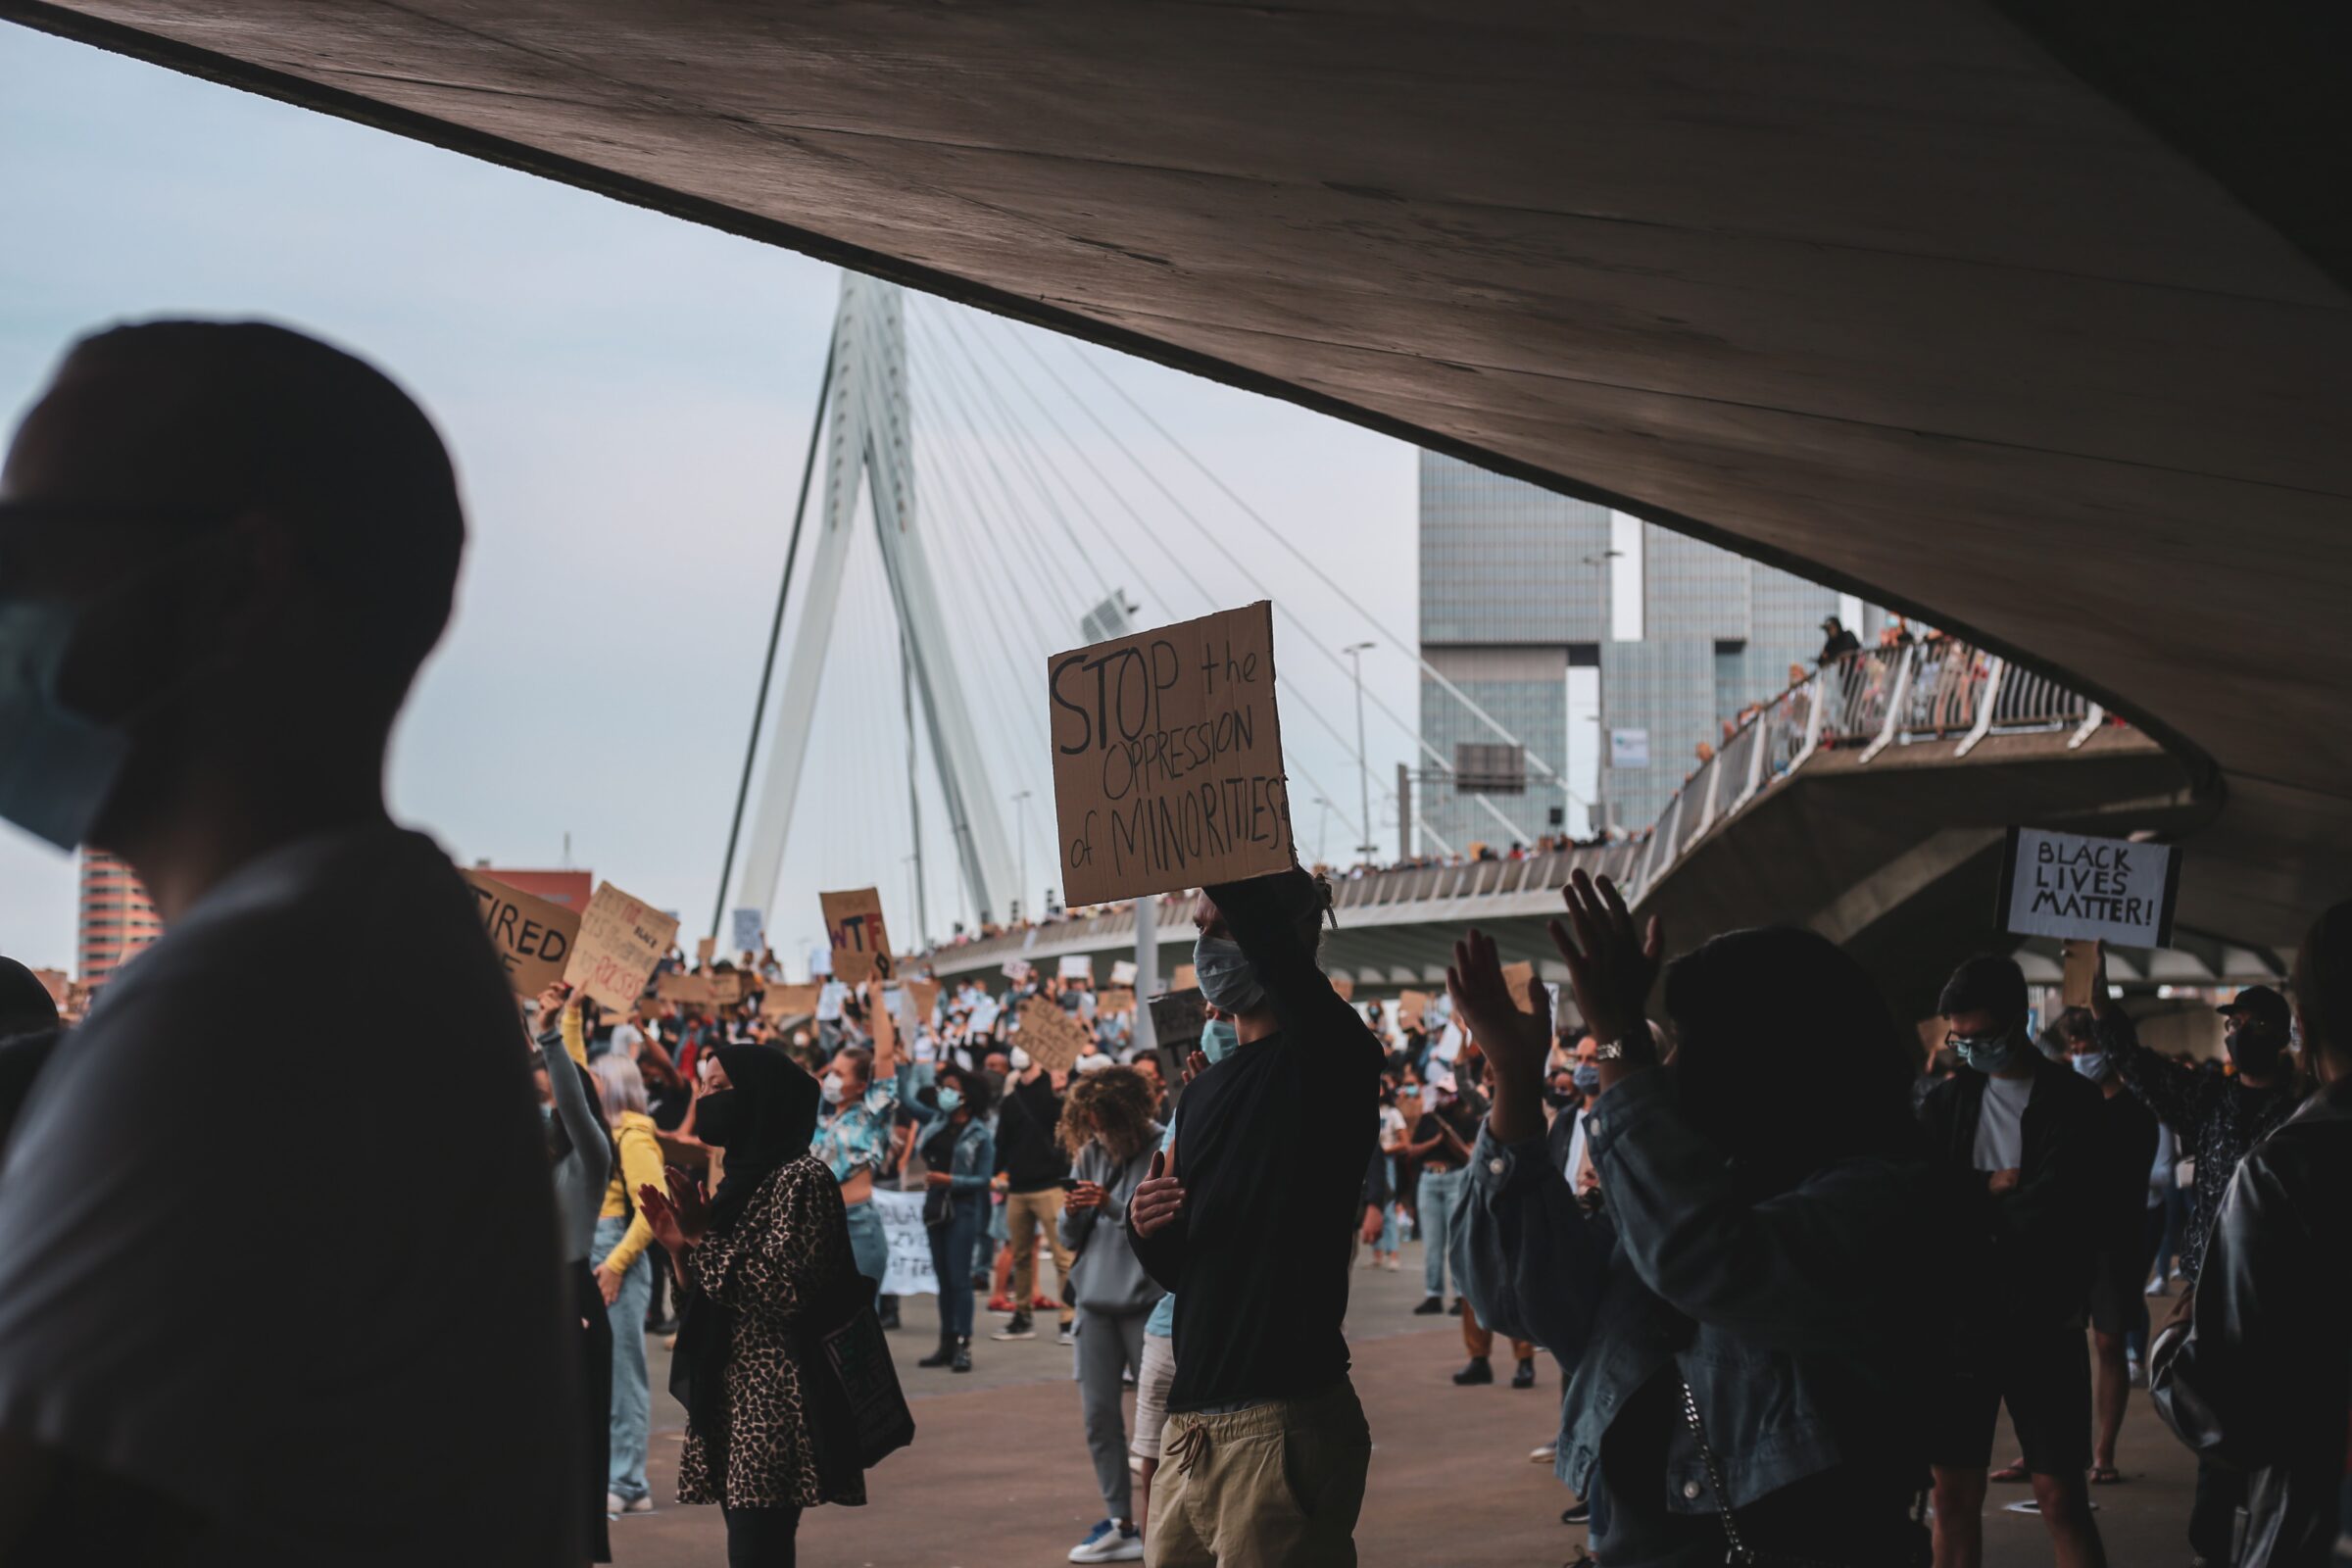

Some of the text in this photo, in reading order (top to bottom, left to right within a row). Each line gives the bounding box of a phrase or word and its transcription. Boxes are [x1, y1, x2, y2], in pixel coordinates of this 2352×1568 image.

[1050, 640, 1257, 756] STOP the
[1102, 705, 1253, 801] OPPRESSION
[1070, 776, 1279, 877] of MINORITIES
[2037, 840, 2132, 872] BLACK
[2031, 889, 2154, 927] MATTER!
[2035, 864, 2129, 897] LIVES
